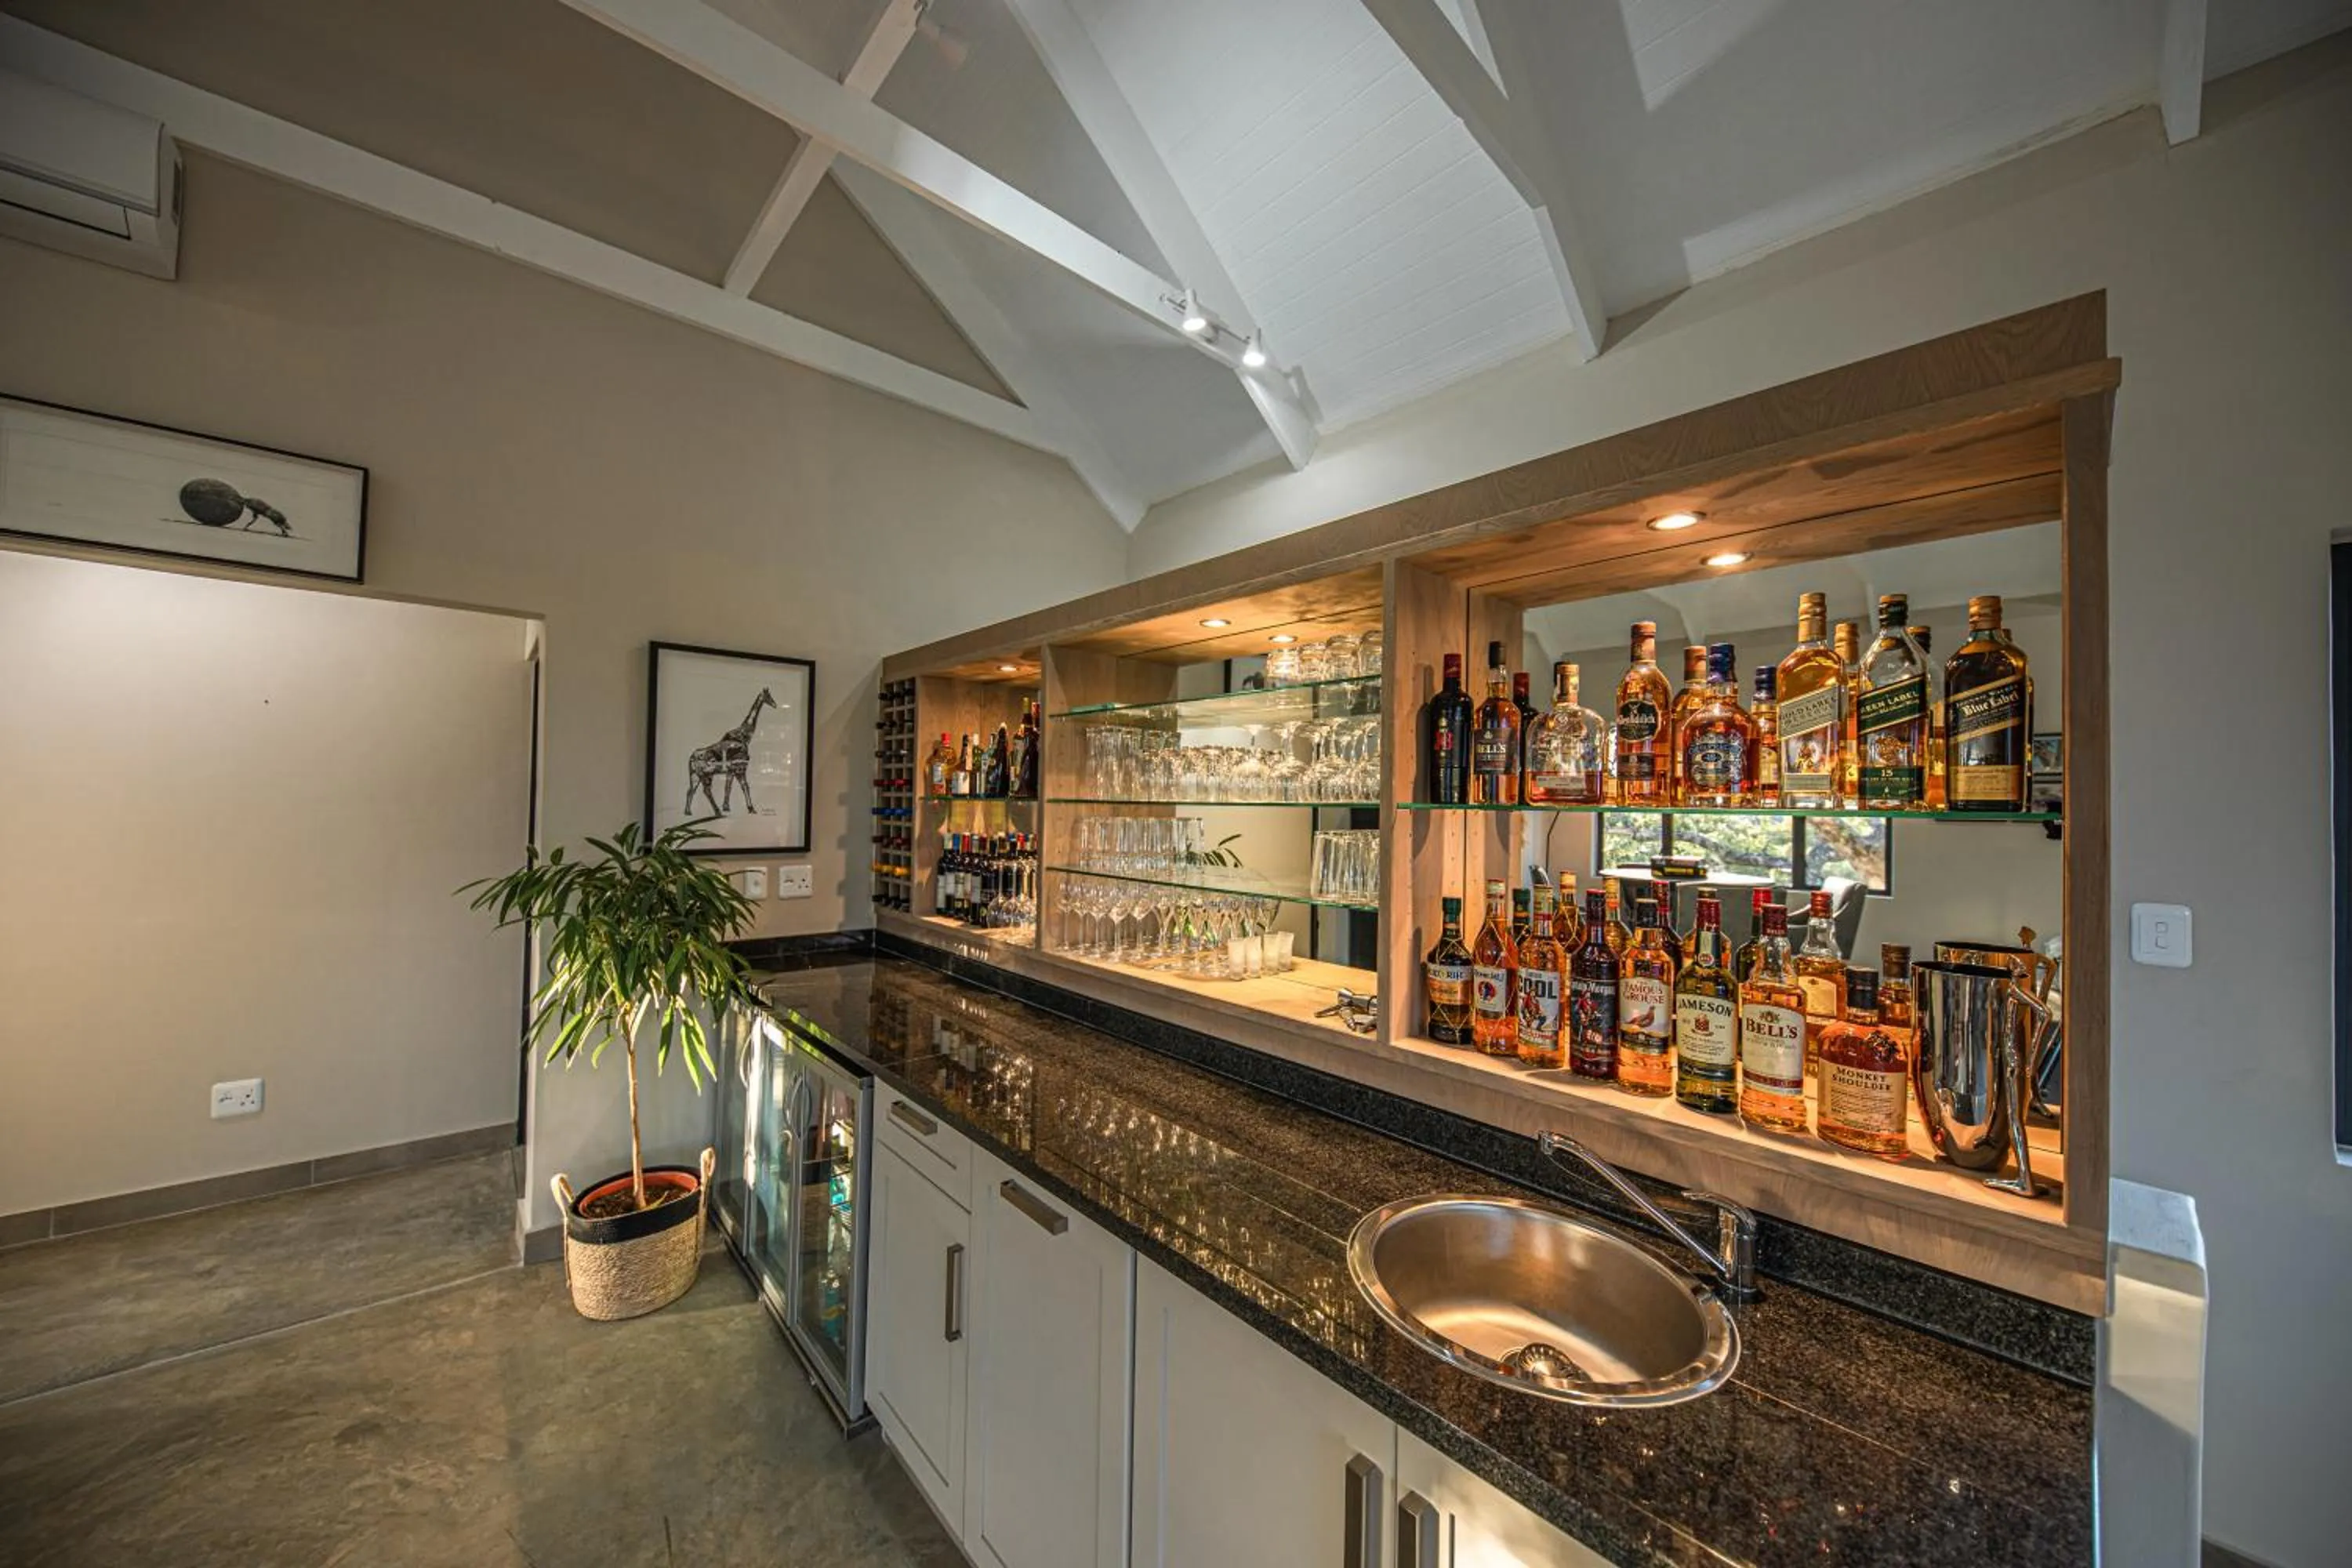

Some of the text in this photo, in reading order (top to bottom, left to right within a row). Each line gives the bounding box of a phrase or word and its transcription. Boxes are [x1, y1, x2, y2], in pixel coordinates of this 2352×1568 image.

[1888, 691, 1920, 705] LABEL
[1962, 702, 1989, 716] Blue
[1989, 691, 2019, 707] Label
[1679, 998, 1732, 1018] JAMESON
[1745, 1017, 1798, 1039] BELL'S
[1831, 1073, 1893, 1091] SHOULDER
[1836, 1065, 1886, 1083] MONKEY
